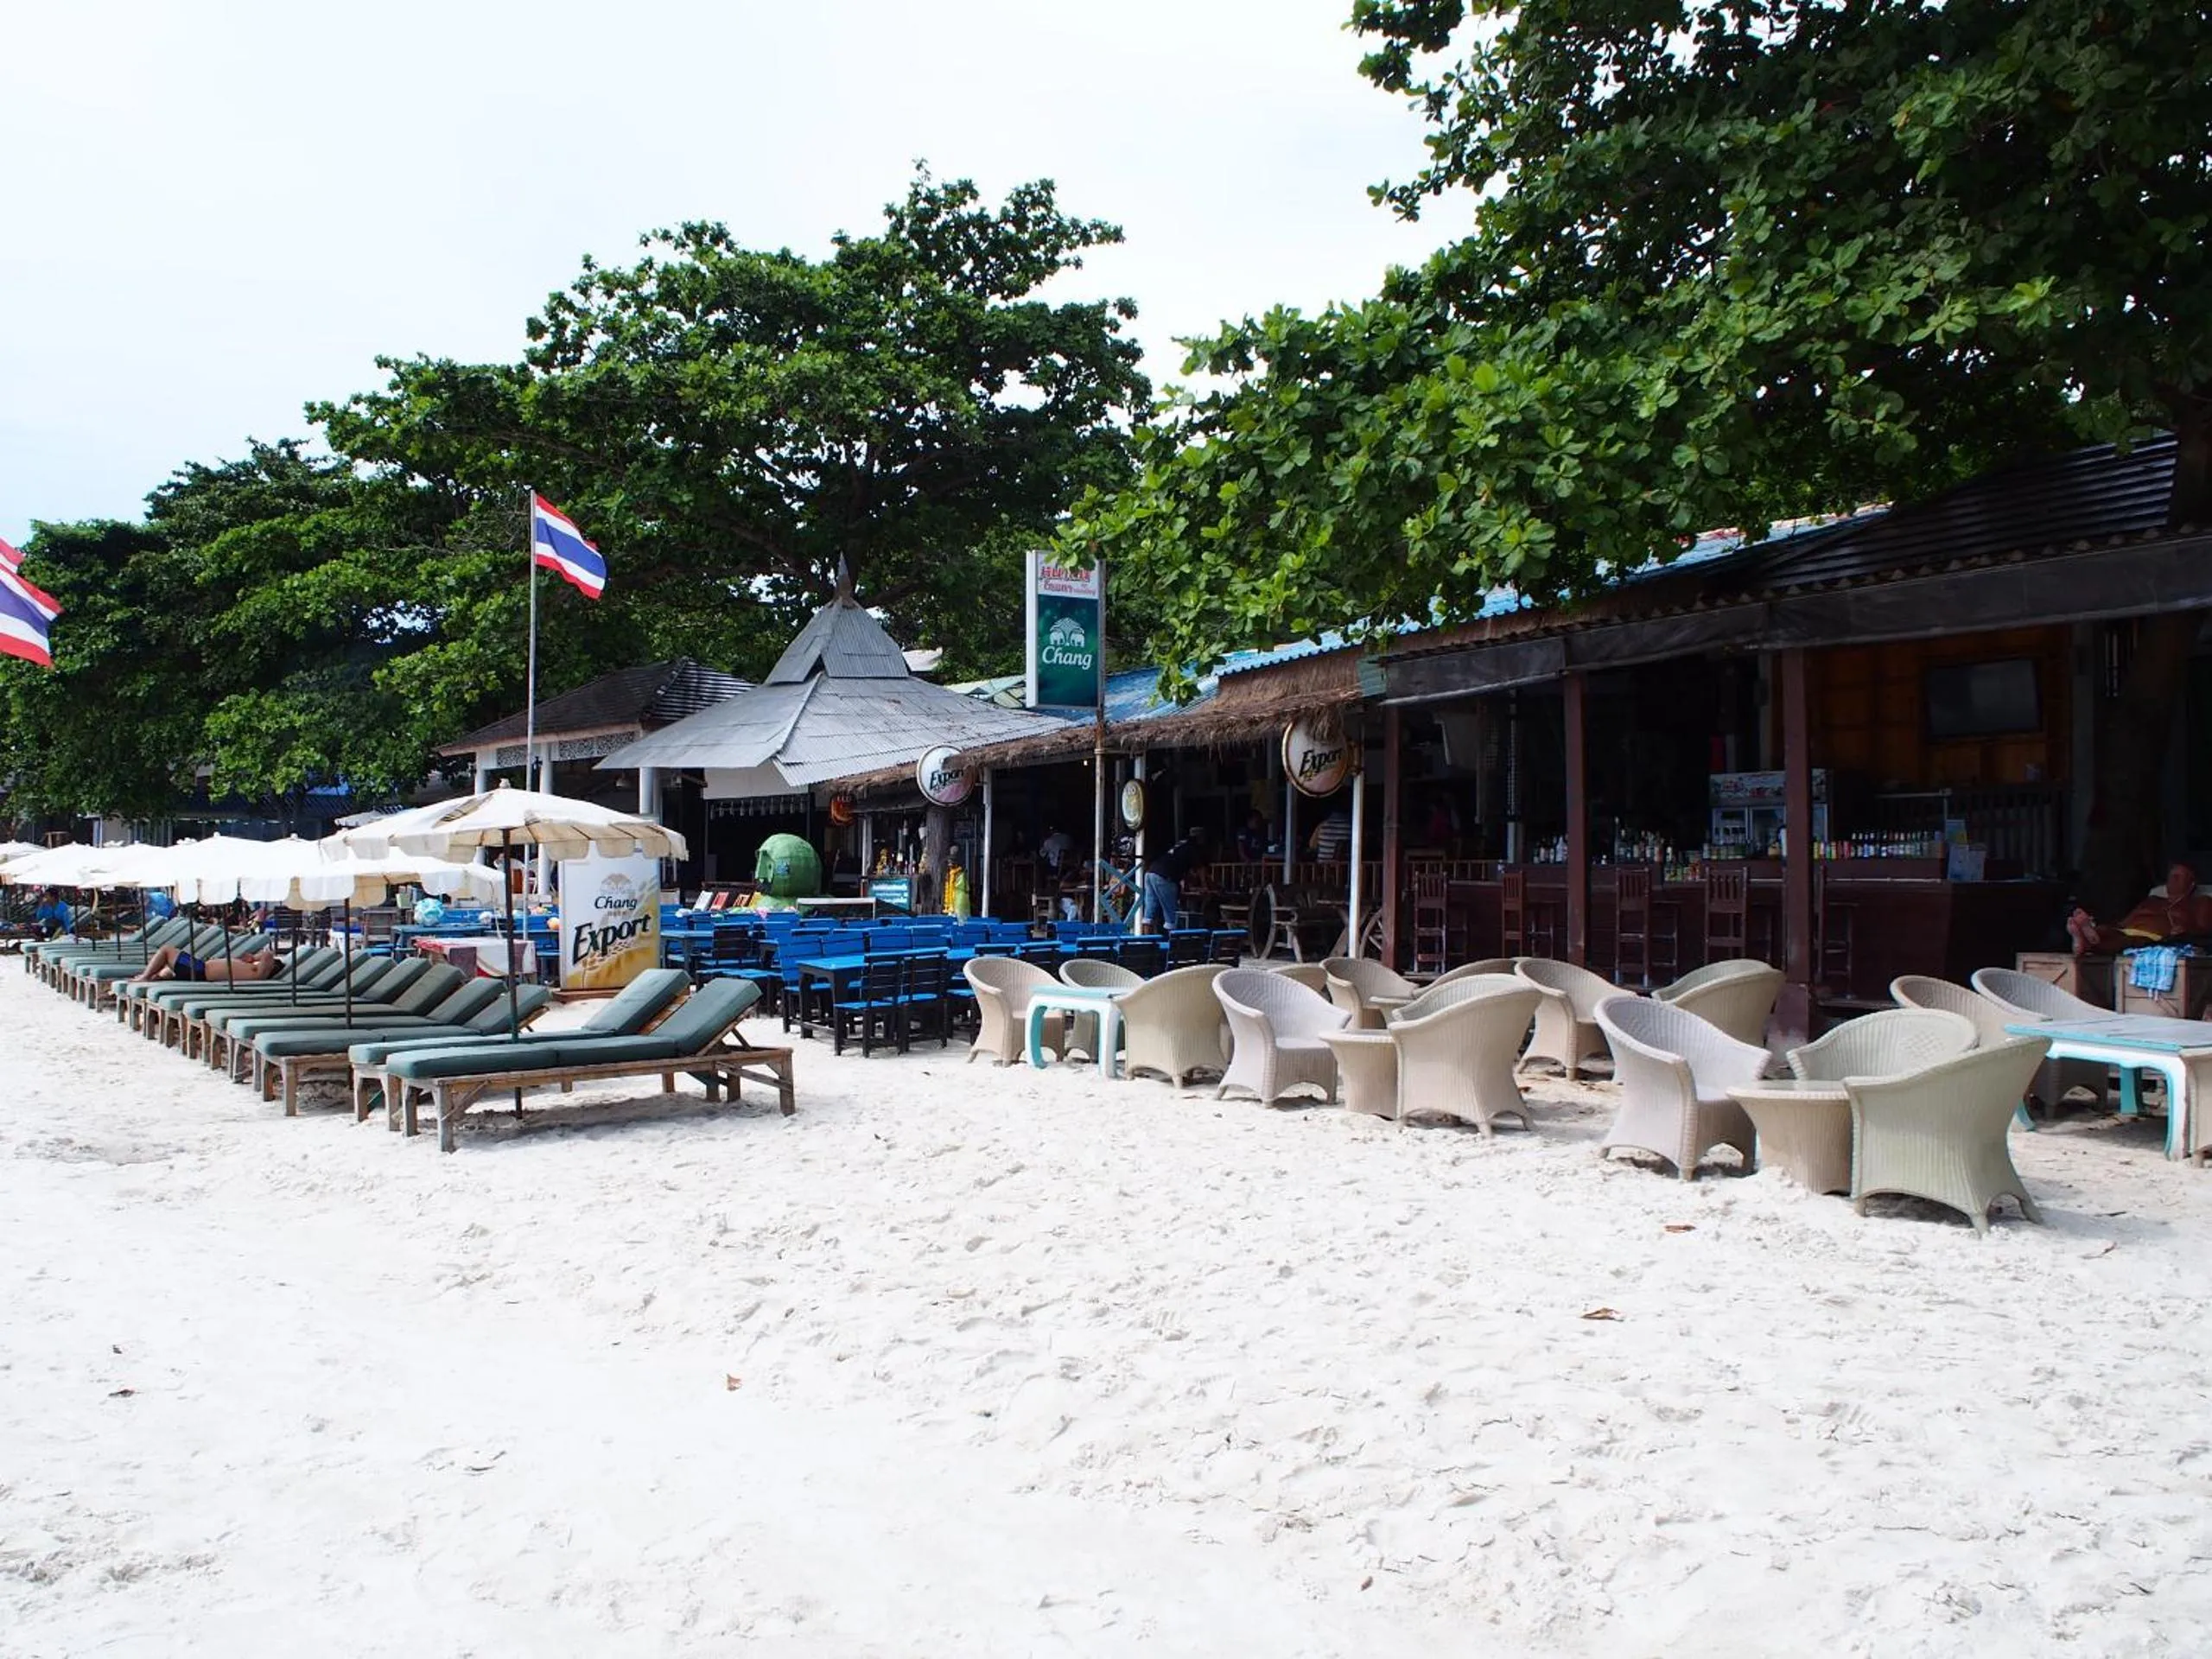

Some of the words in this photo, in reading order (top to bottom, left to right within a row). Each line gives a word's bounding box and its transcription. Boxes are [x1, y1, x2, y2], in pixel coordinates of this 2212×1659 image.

[1042, 645, 1092, 670] Chang
[594, 896, 638, 910] Chang
[573, 914, 651, 965] Export
